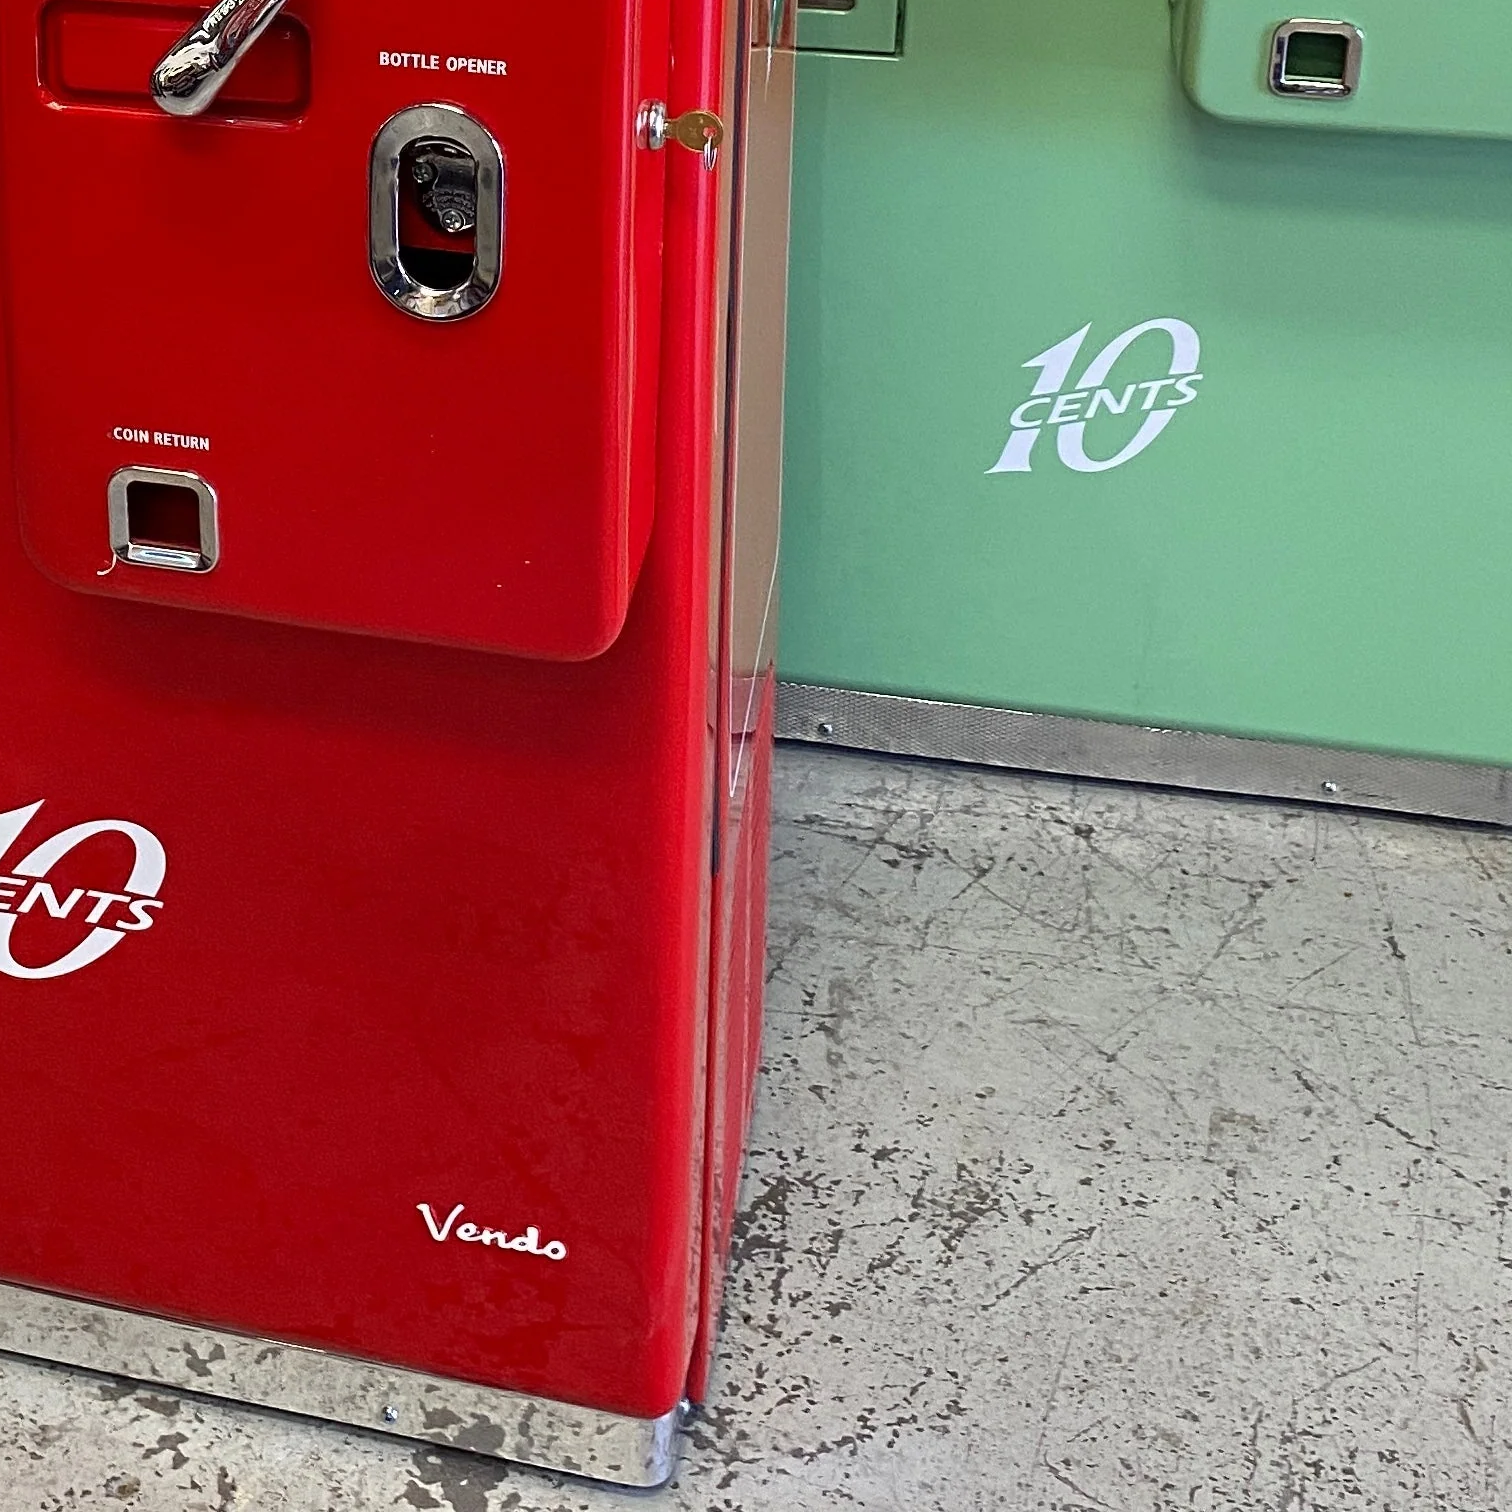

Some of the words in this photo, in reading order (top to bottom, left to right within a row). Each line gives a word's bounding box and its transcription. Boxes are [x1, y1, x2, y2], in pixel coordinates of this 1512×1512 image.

[379, 51, 440, 70] BOTTLE
[445, 56, 508, 76] OPENER
[984, 317, 1201, 475] 10
[1009, 373, 1204, 428] CENTS
[113, 426, 149, 443] COIN
[153, 431, 210, 451] RETURN
[416, 1203, 568, 1260] Vendo
